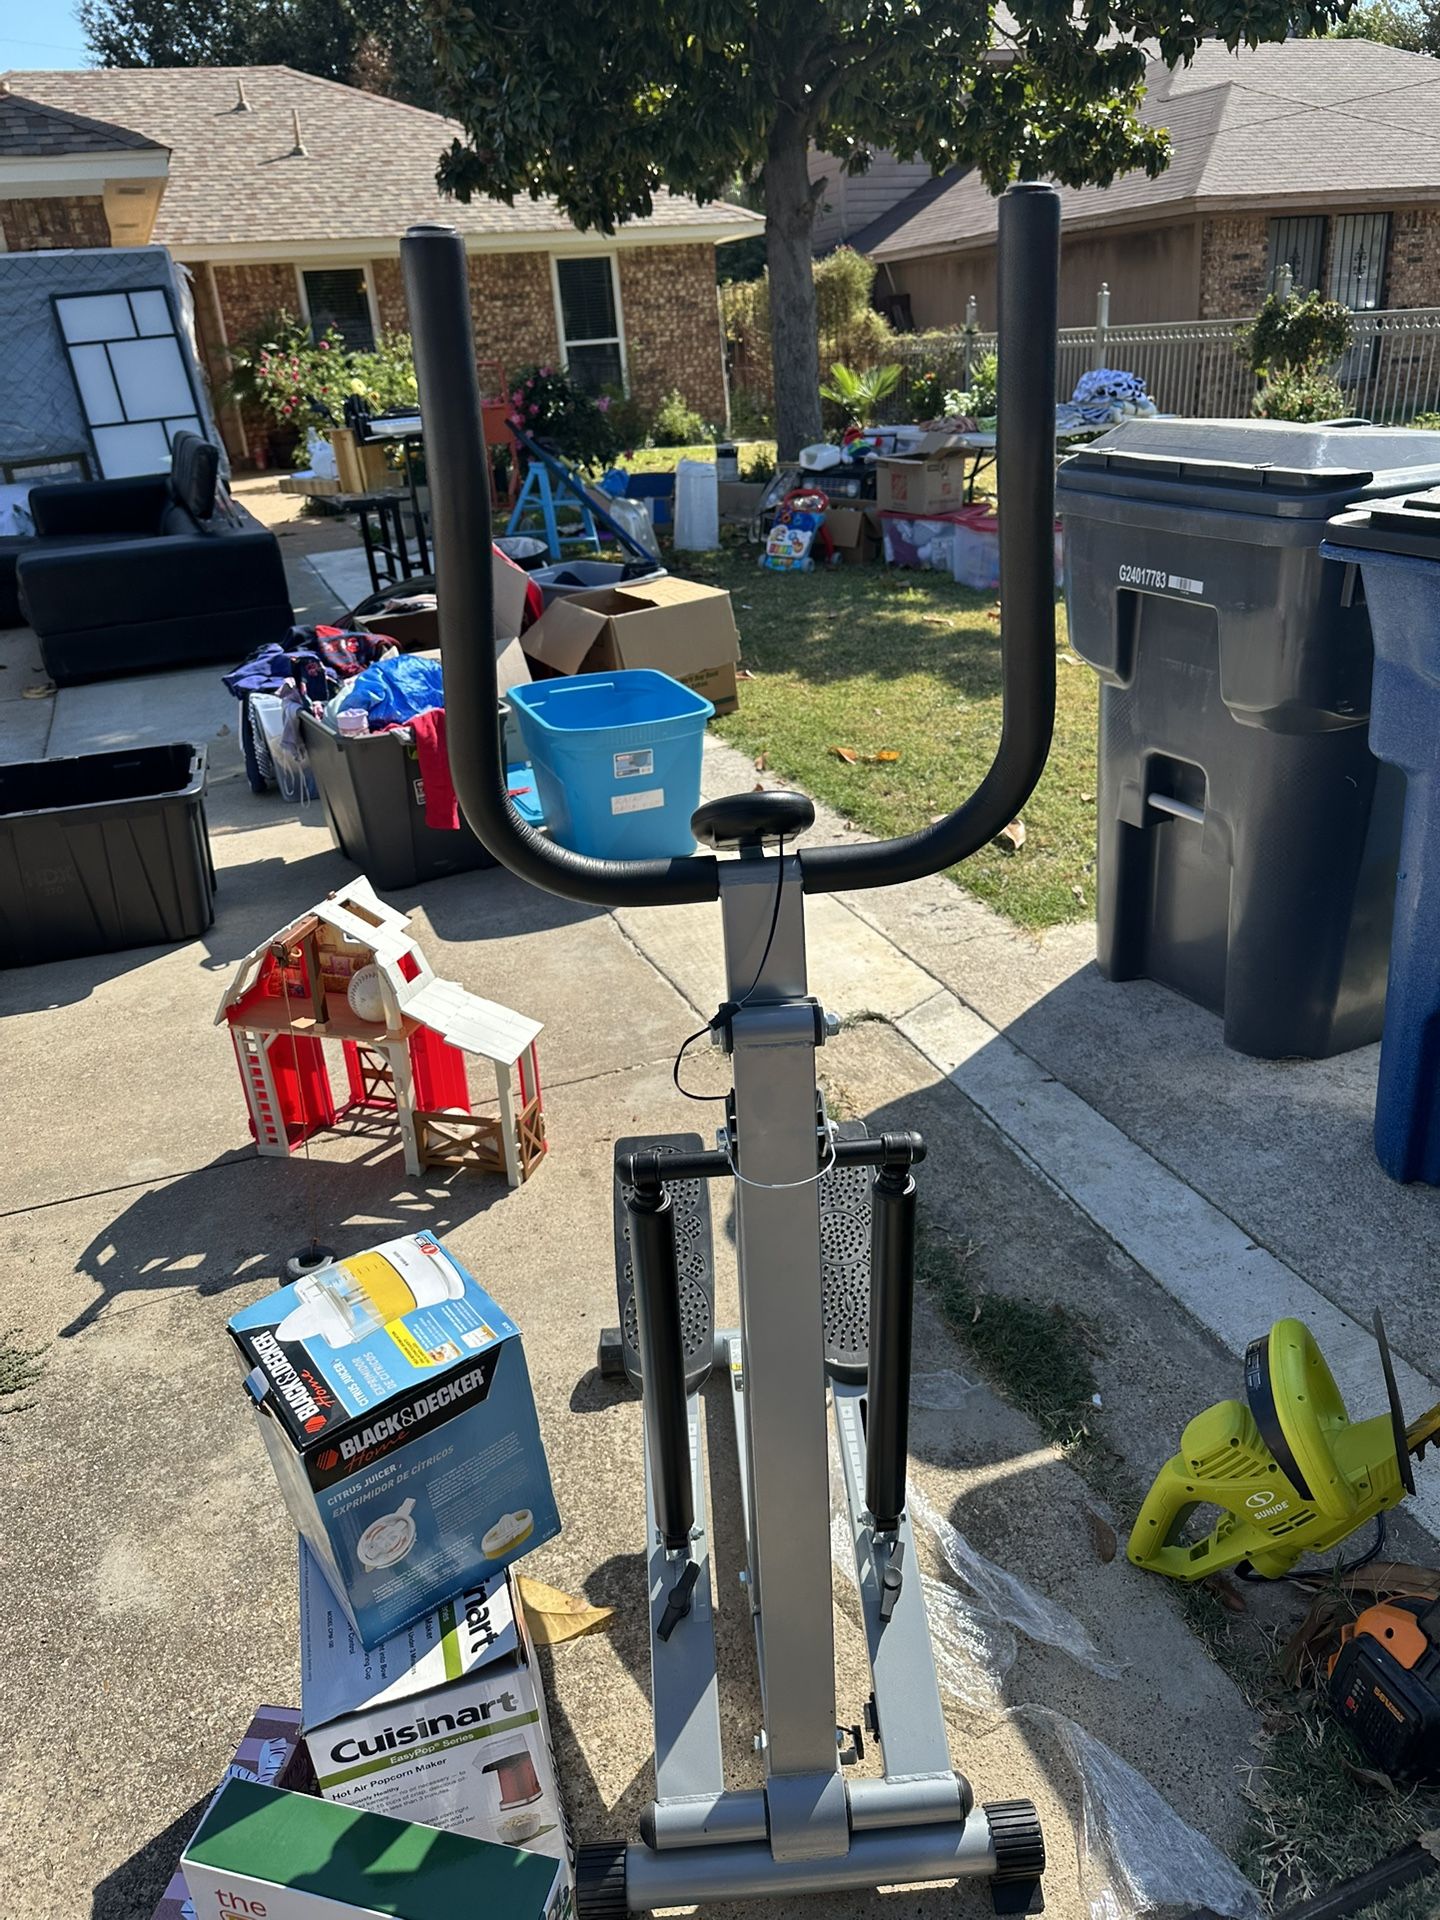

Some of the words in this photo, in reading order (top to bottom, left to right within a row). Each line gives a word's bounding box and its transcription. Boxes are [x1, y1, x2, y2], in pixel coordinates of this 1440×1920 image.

[1119, 565, 1166, 588] G24017783
[252, 1331, 320, 1422] BLACK&DECKER
[301, 1369, 336, 1408] Home
[346, 1382, 369, 1407] CITRUS
[339, 1367, 485, 1460] BLACK&DECKER
[344, 1430, 409, 1472] Home
[326, 1482, 362, 1505] CITRUS
[332, 1479, 394, 1518] EXPRIMIDOR
[395, 1470, 408, 1483] DE
[411, 1445, 454, 1474] CÍTRICOS
[331, 1692, 516, 1763] Cuisinart
[442, 1733, 474, 1747] Series
[332, 1789, 350, 1800] Hot
[353, 1783, 367, 1793] Air
[369, 1768, 412, 1787] Popcorn
[415, 1757, 447, 1772] Maker
[373, 1785, 400, 1797] Healthy
[215, 1889, 267, 1917] the
